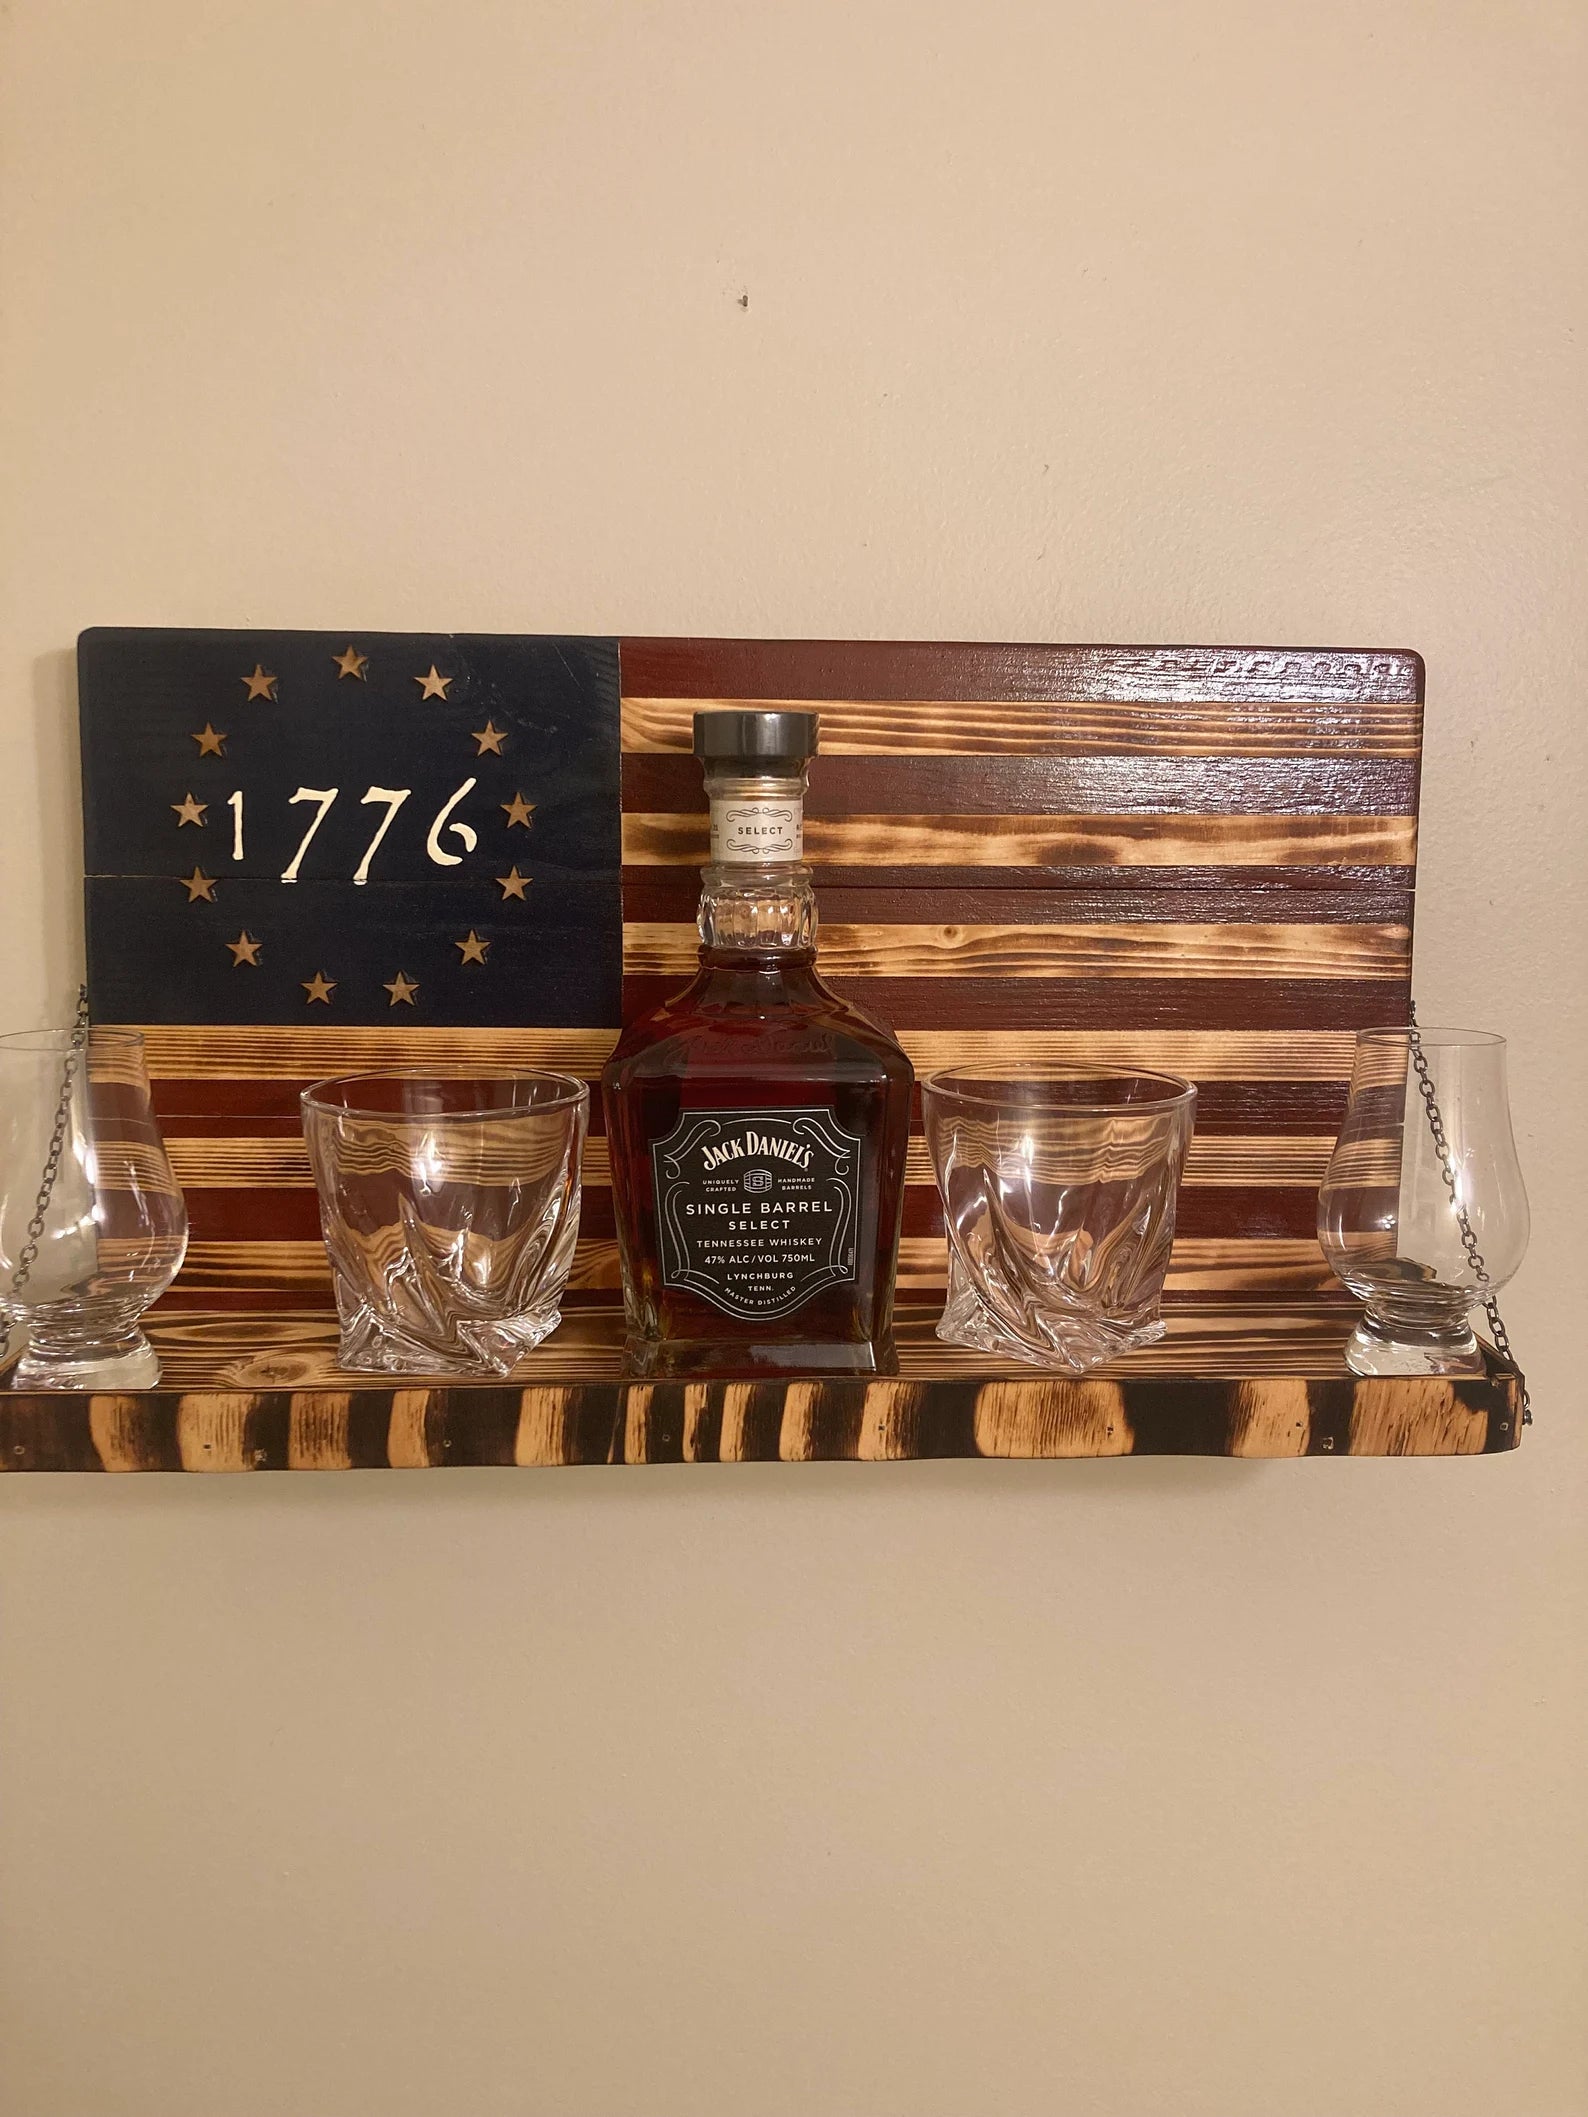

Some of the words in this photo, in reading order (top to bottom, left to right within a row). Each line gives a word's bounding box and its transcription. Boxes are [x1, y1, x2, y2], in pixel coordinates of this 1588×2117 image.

[227, 777, 477, 886] 1776
[737, 826, 783, 835] SELECT
[701, 1138, 745, 1171] JACK
[746, 1131, 814, 1169] DANIEL'S
[686, 1203, 751, 1215] SINGLE
[760, 1201, 833, 1213] BARREL
[728, 1220, 790, 1230] SELECT
[697, 1239, 765, 1248] TENNESSEE
[769, 1237, 822, 1247] WHISKEY
[704, 1256, 725, 1264] 47%
[781, 1254, 815, 1263] 750ML
[727, 1272, 794, 1281] LYNCHBURG
[724, 1287, 754, 1305] MASTER
[757, 1286, 796, 1306] DISTILLED
